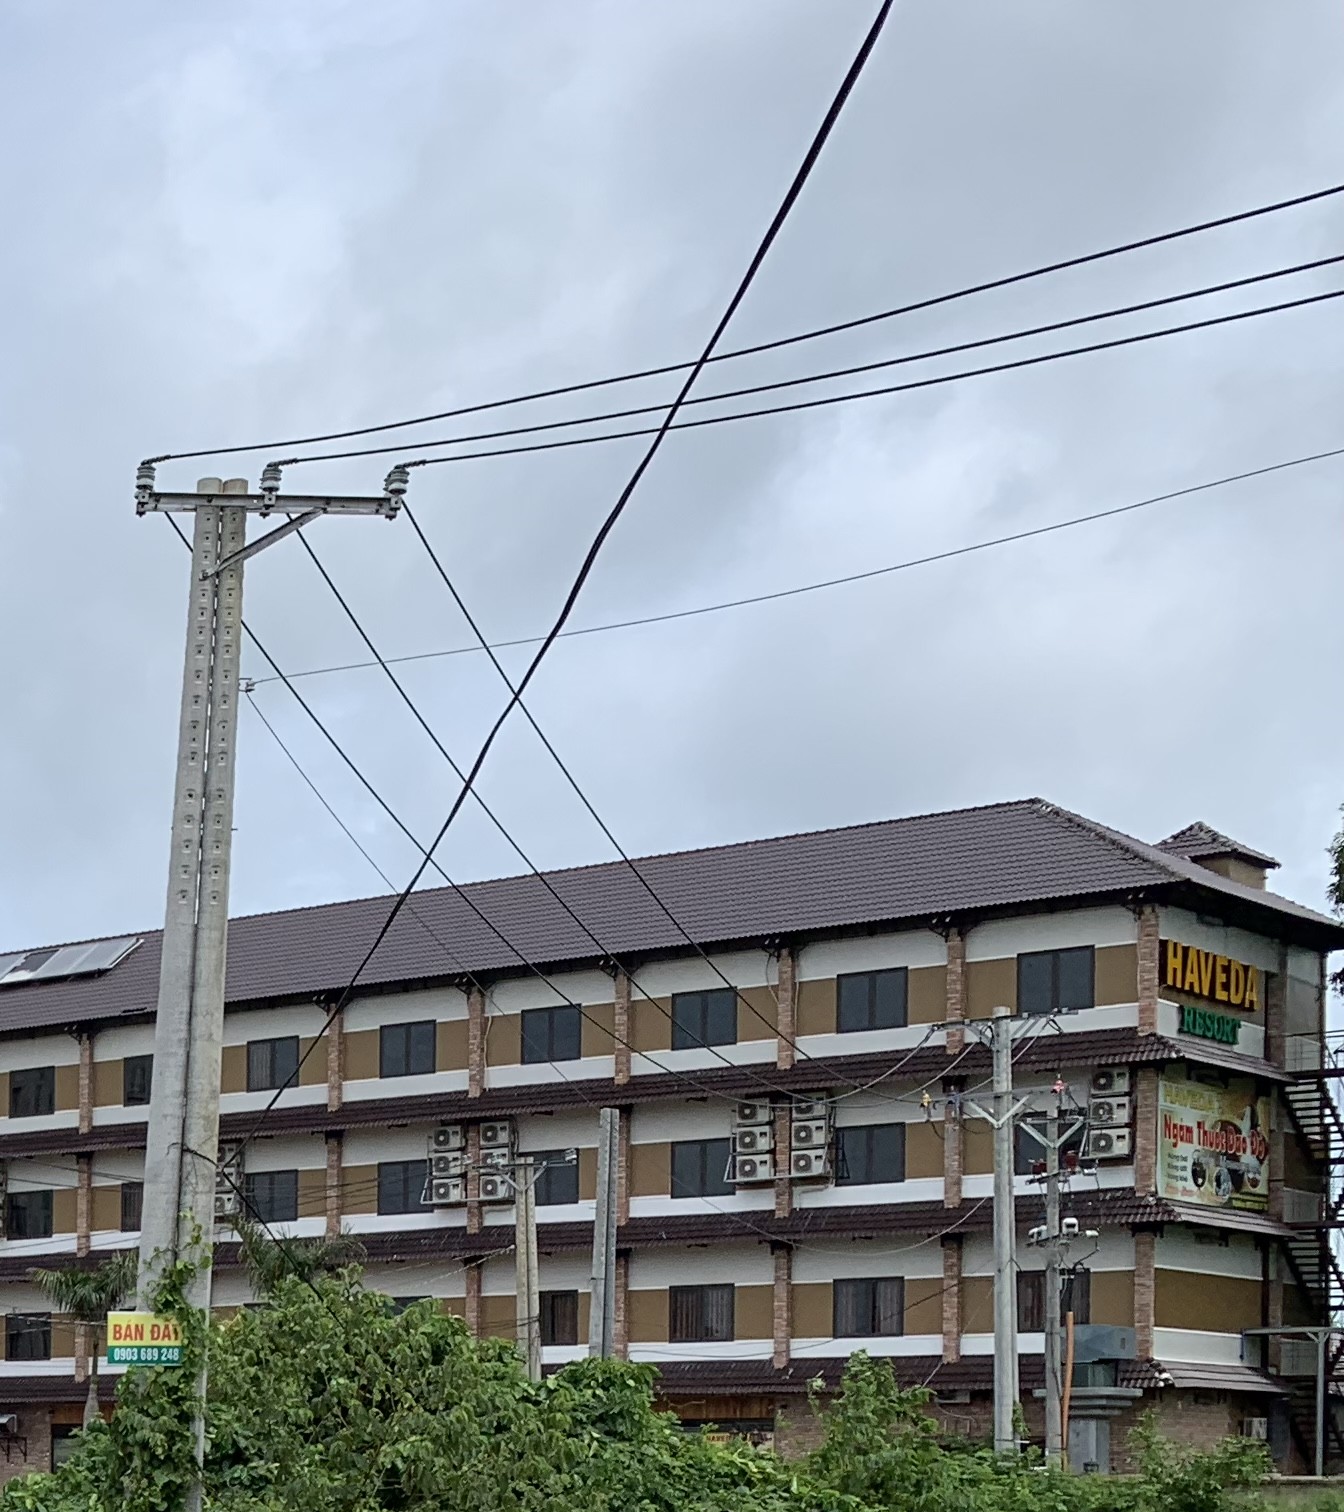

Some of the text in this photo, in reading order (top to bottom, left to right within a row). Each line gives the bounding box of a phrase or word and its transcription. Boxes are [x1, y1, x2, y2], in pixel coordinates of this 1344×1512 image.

[1166, 940, 1259, 1011] HAVEDA
[1183, 1006, 1241, 1045] RESORT
[112, 1319, 144, 1341] BÁN
[113, 1347, 180, 1361] 0903 689 248
